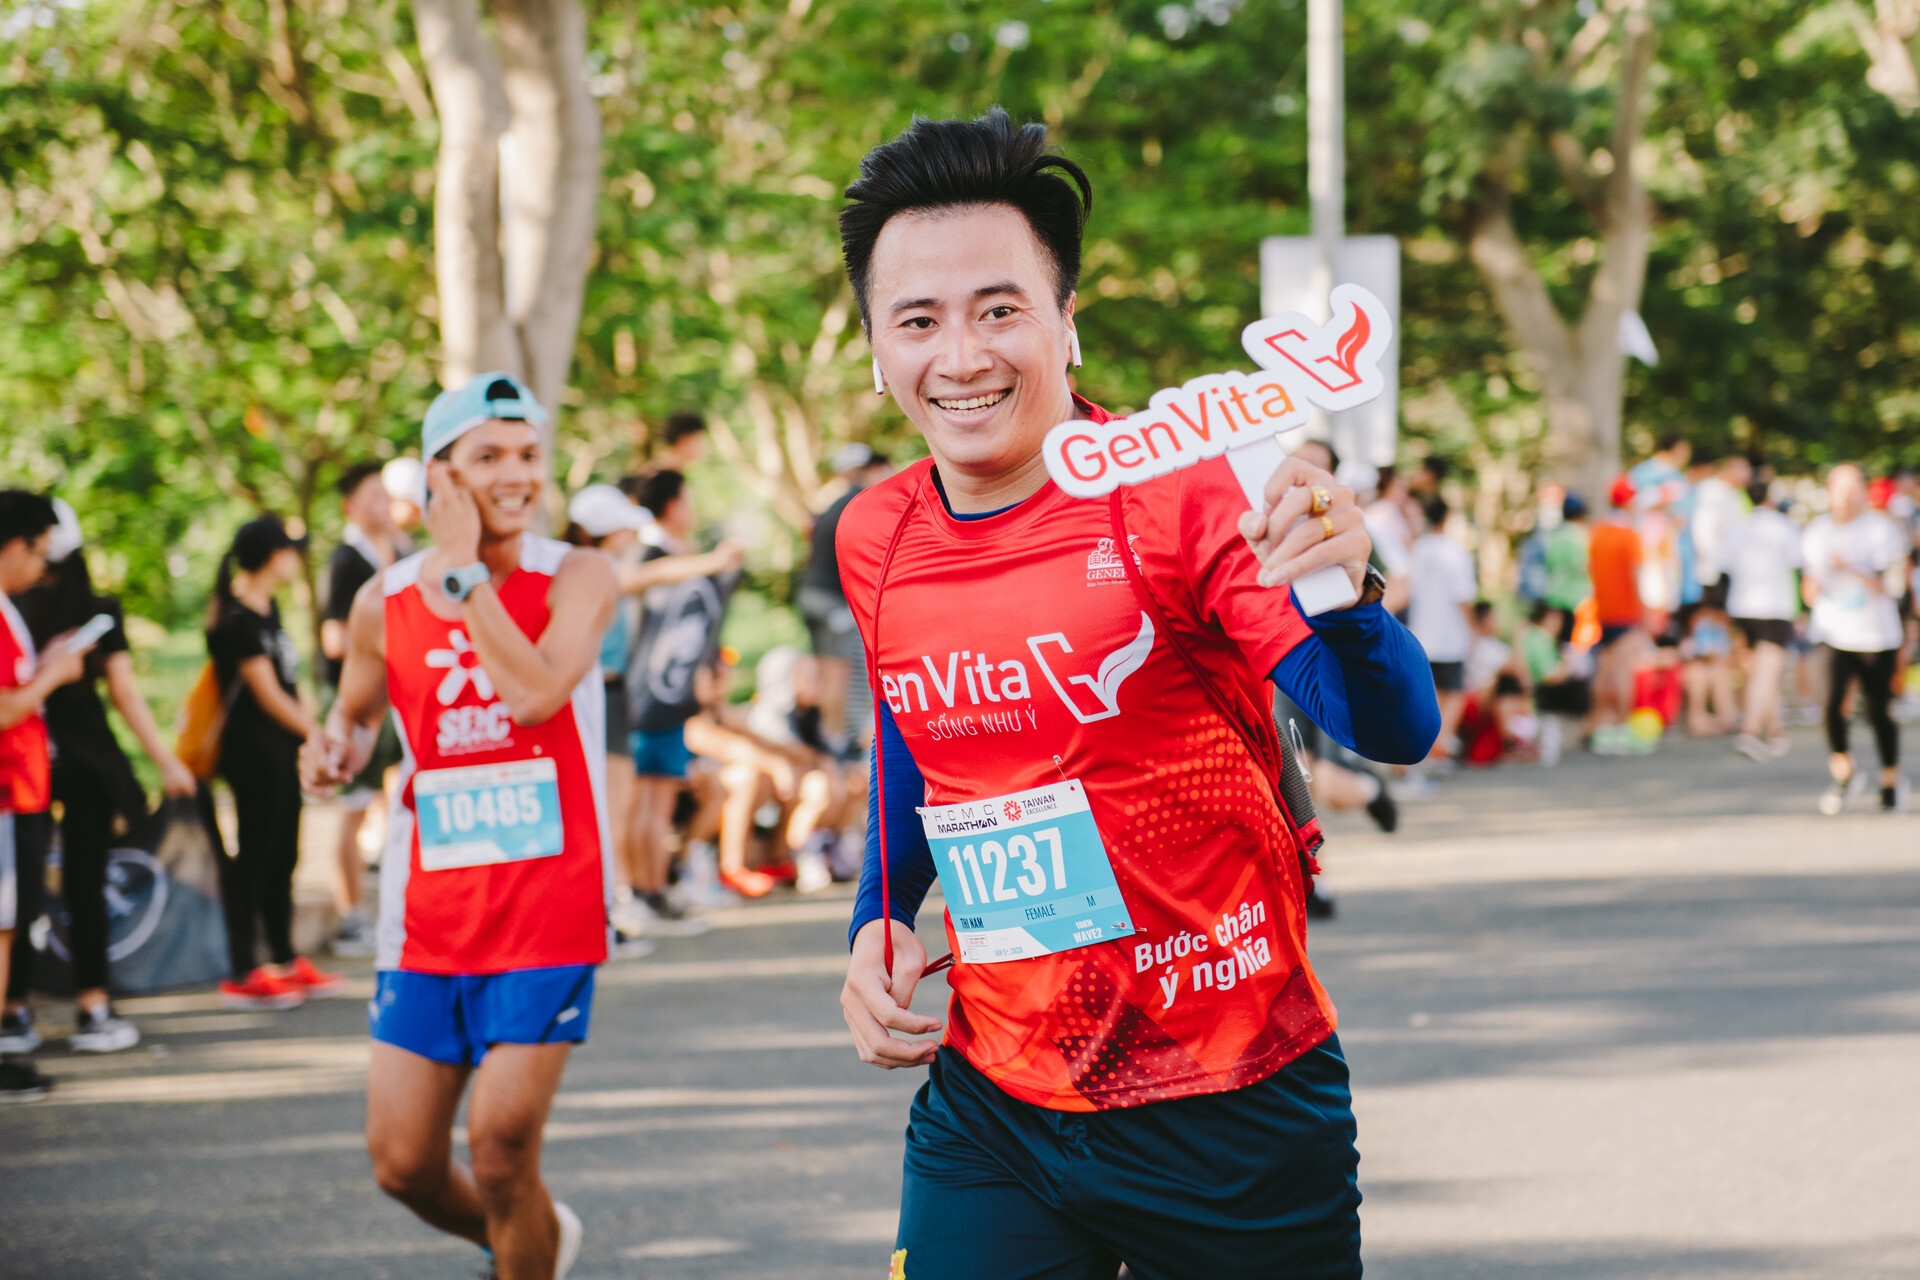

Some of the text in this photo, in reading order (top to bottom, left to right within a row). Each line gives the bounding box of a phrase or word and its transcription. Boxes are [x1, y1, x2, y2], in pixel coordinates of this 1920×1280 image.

[1060, 382, 1297, 482] GenVita
[878, 650, 1032, 714] enVita
[926, 703, 1038, 741] SỐNG NHƯ Ý
[433, 785, 543, 834] 10485
[1022, 793, 1056, 810] TAIWAN
[1026, 802, 1058, 816] EXCELLENCE
[937, 816, 998, 834] MARATHON
[947, 826, 1068, 906] 11237
[1024, 903, 1057, 921] FEMALE
[1085, 894, 1097, 908] M
[969, 917, 985, 929] NAM
[1072, 927, 1104, 944] WAVE2
[1134, 900, 1266, 974] Bước chân
[1158, 935, 1272, 1010] ý nghĩa
